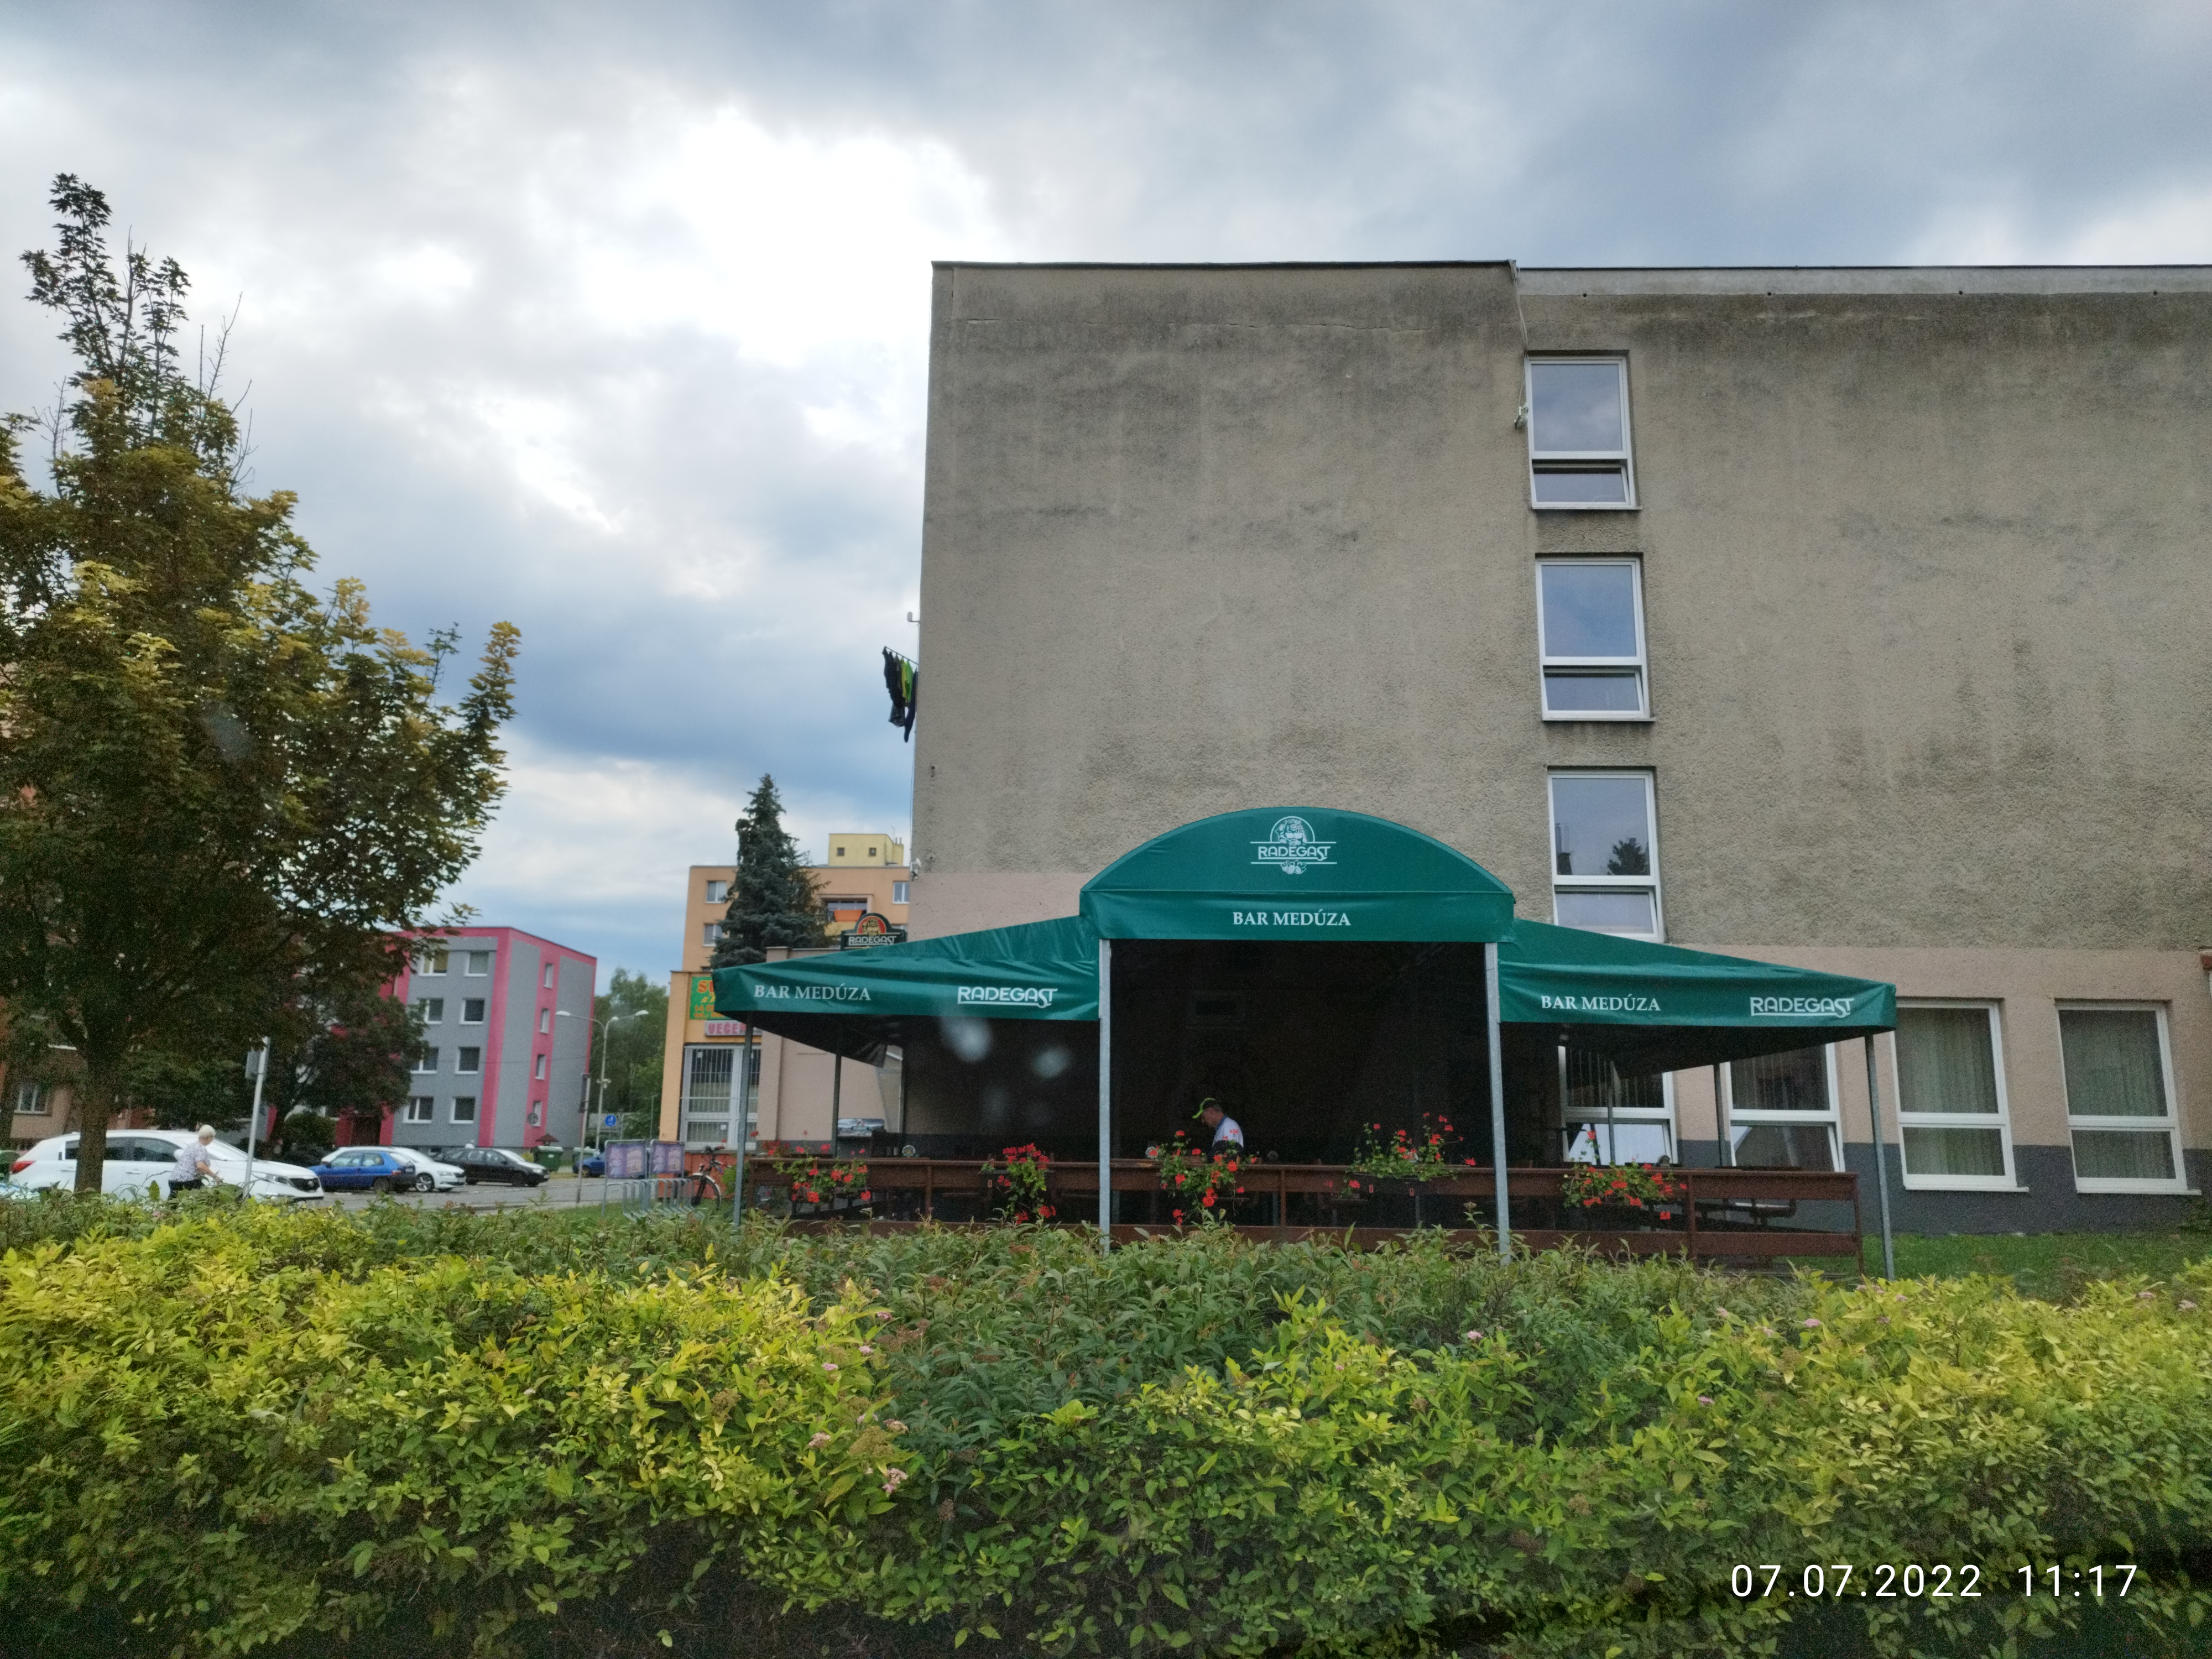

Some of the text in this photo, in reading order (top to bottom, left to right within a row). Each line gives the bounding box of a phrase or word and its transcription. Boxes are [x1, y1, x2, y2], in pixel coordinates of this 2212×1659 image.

[1258, 846, 1331, 861] RADEGAST
[1233, 909, 1351, 926] BAR MEDÚZA
[848, 936, 897, 946] RADEGAST
[754, 983, 872, 1000] BAR MEDÚZA
[957, 986, 1058, 1009] RADEGAST
[1541, 993, 1661, 1011] BAR MEDÚZA
[1750, 997, 1855, 1019] RADEGAST
